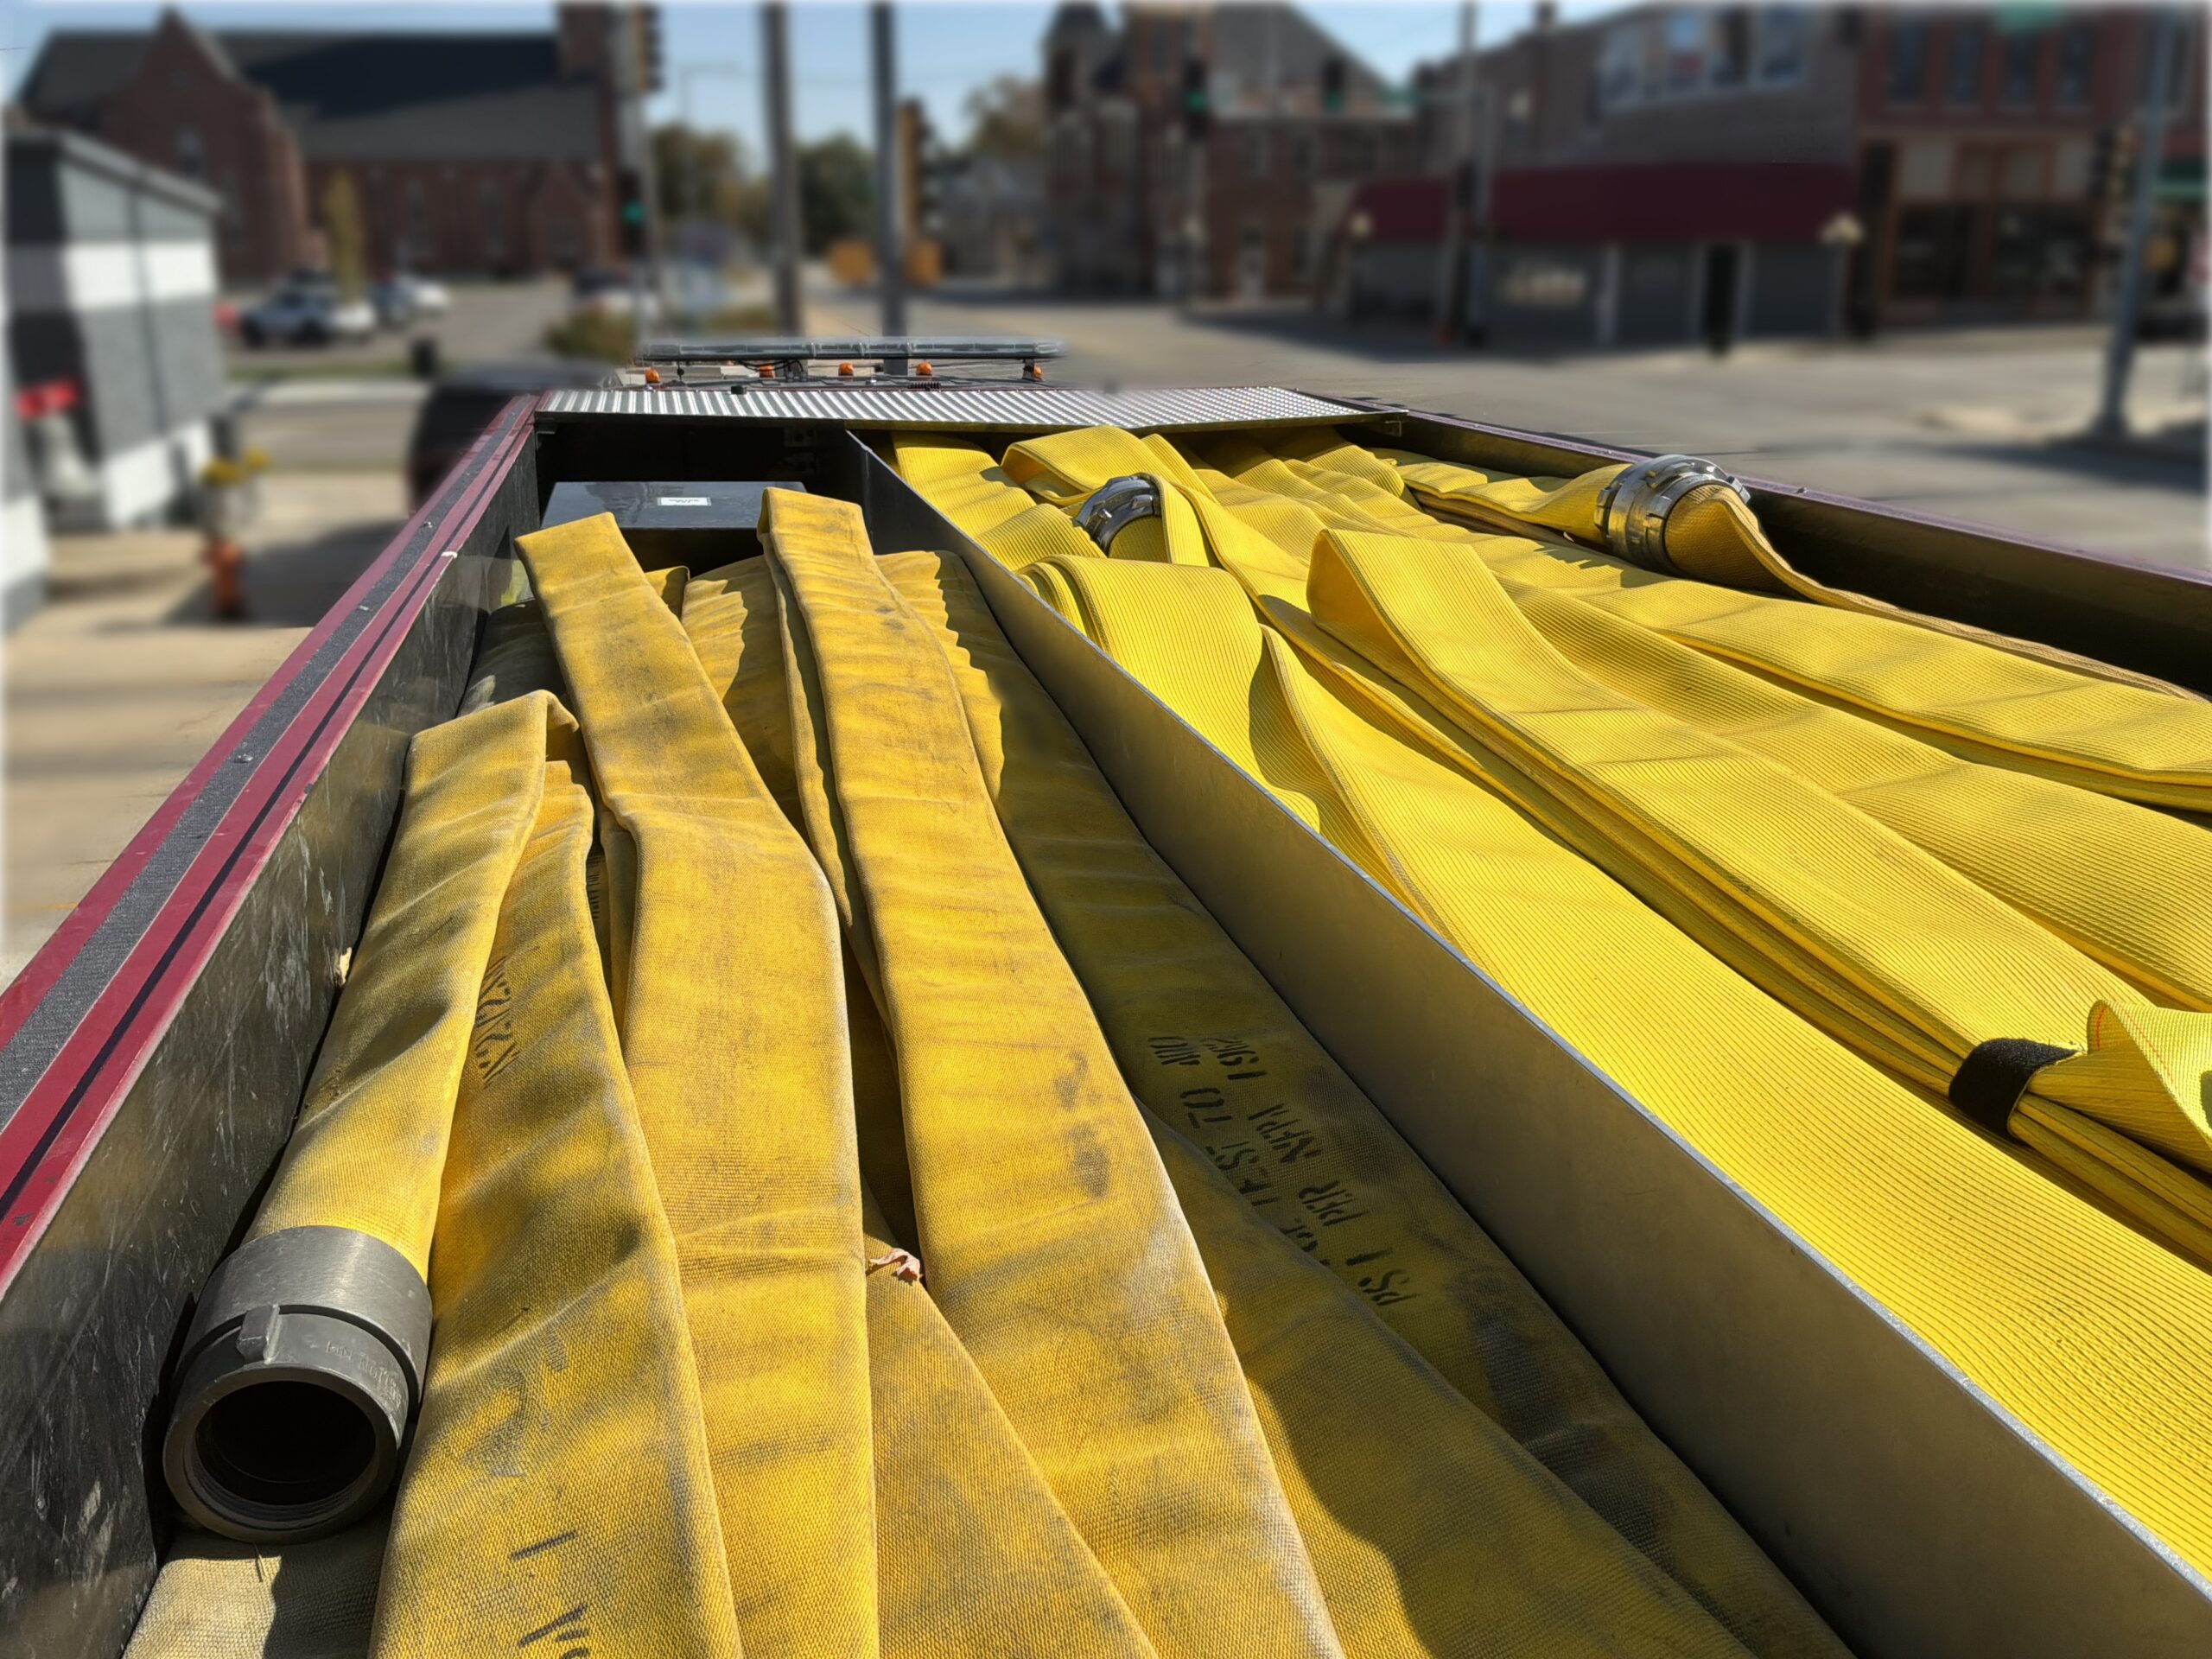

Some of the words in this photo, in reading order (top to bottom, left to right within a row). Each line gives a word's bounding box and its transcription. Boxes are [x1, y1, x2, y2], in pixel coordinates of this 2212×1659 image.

[1202, 1037, 1268, 1080] 1962
[1180, 1087, 1233, 1129] TO
[1248, 1103, 1323, 1165] NFPA
[1298, 1179, 1366, 1227] PER
